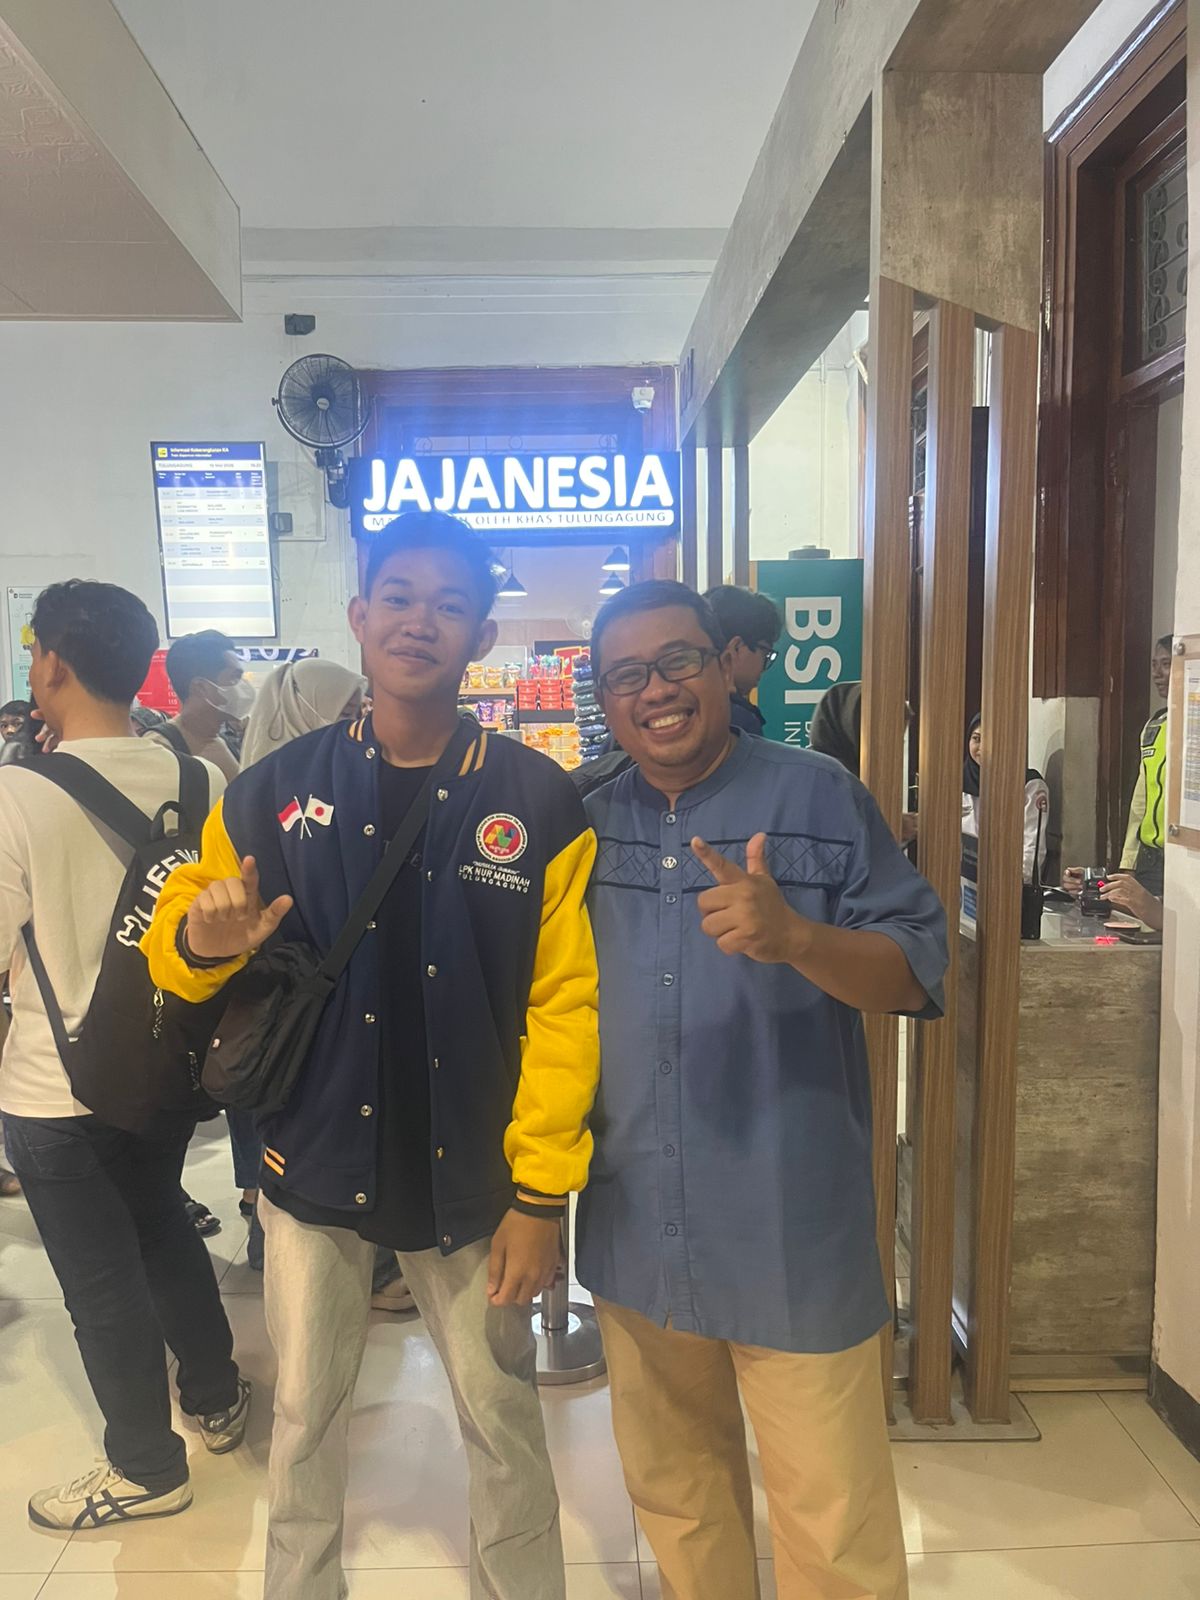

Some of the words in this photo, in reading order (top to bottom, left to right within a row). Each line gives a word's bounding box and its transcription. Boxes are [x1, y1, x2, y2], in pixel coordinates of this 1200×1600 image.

[363, 454, 674, 512] JAJANESIA
[475, 514, 511, 525] OLEH
[516, 514, 553, 524] KHAS
[558, 512, 667, 524] TULUNGAGUNG
[785, 596, 842, 705] BSI
[459, 864, 474, 875] LPK
[475, 867, 493, 878] NUR
[494, 871, 530, 887] MADINAH
